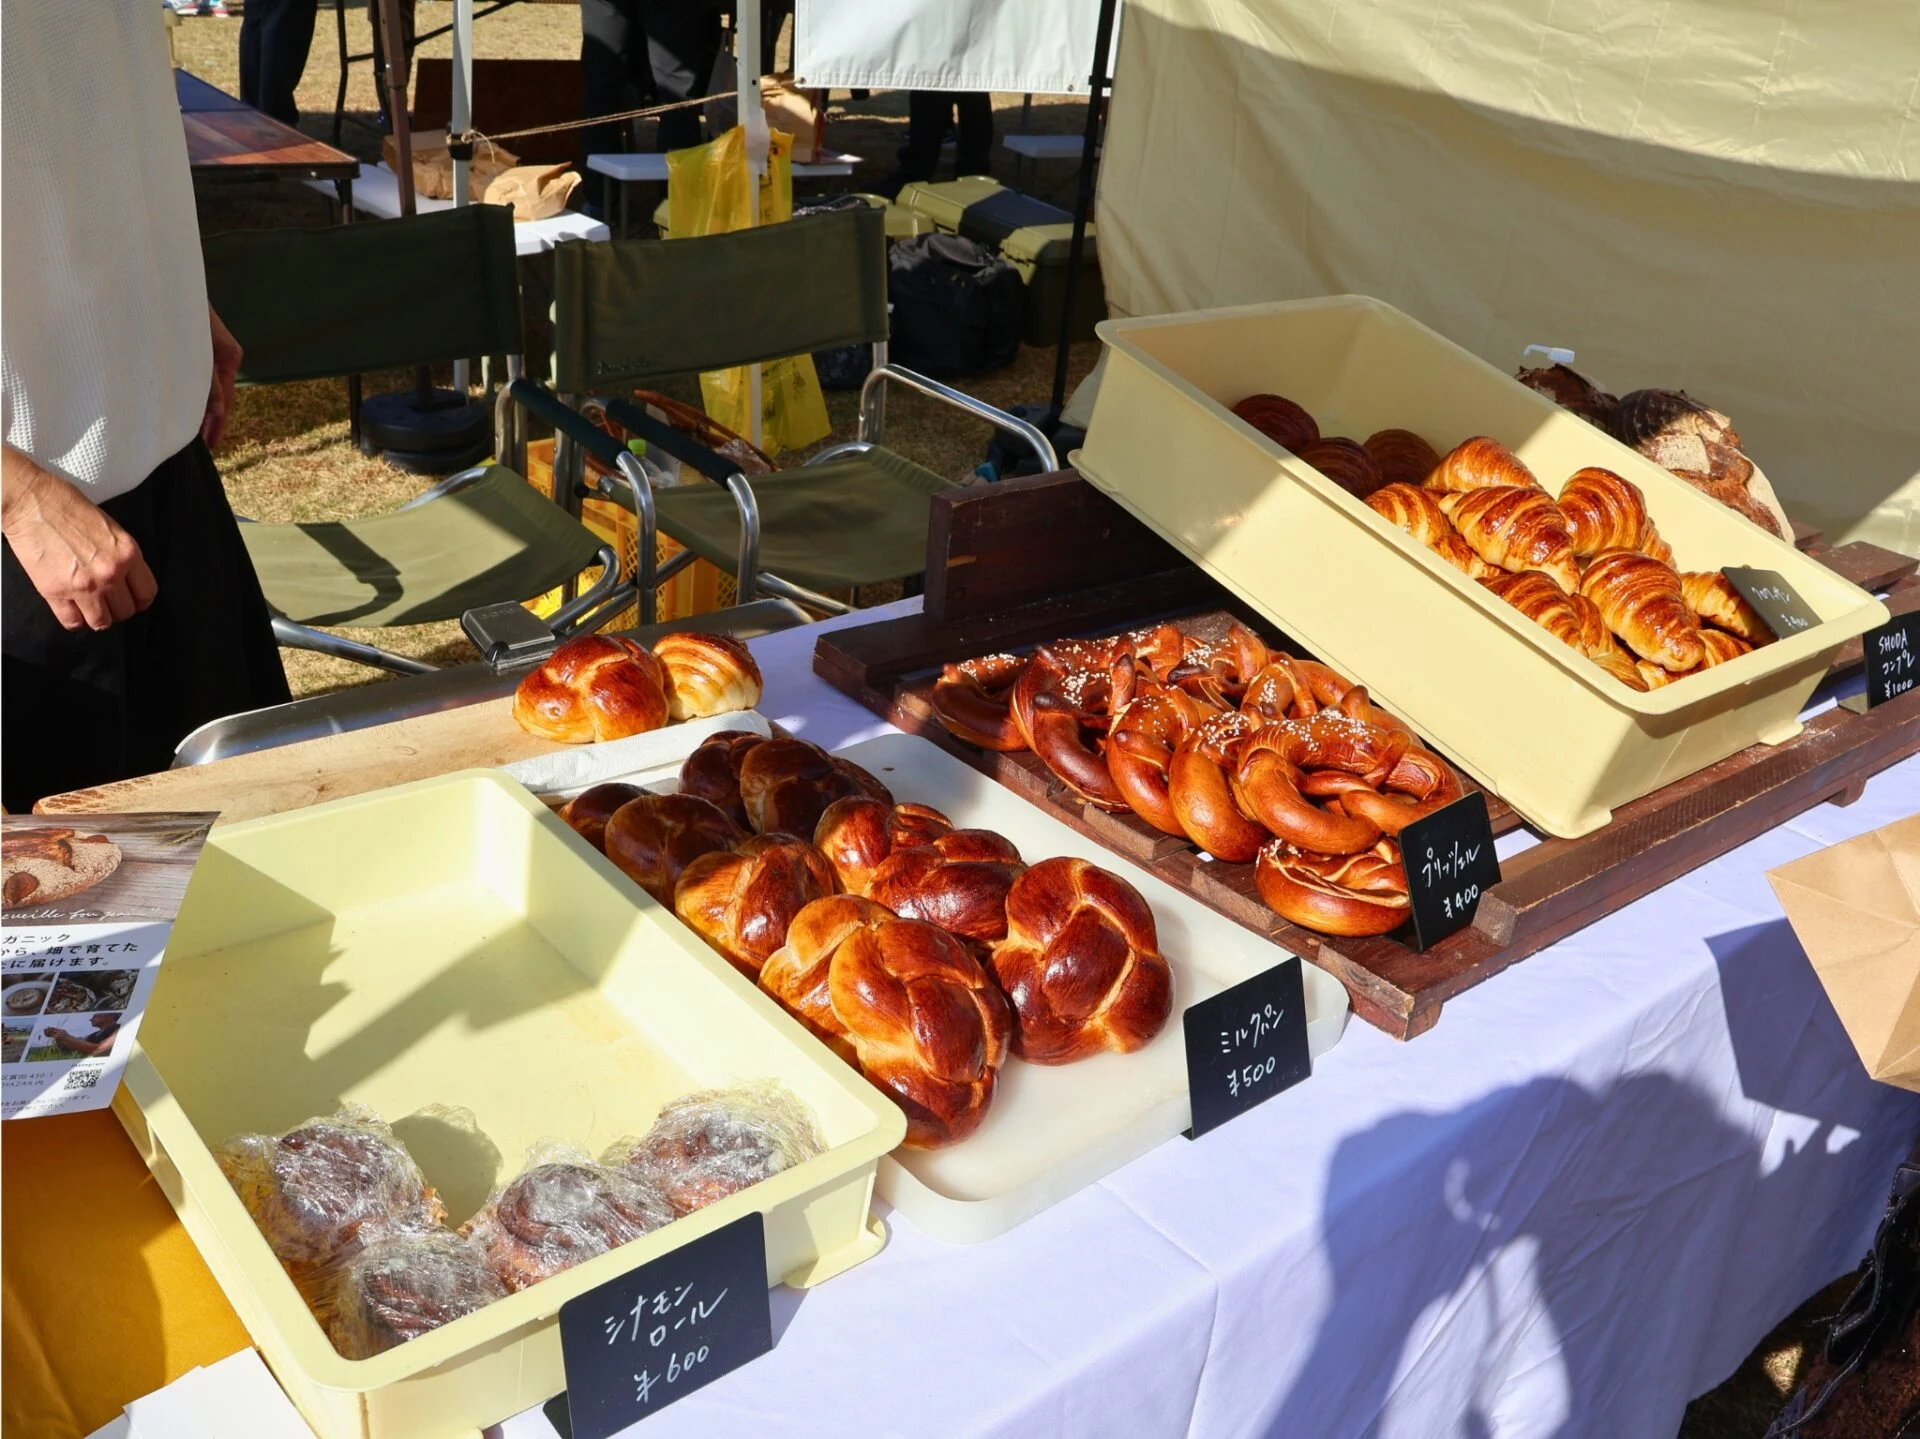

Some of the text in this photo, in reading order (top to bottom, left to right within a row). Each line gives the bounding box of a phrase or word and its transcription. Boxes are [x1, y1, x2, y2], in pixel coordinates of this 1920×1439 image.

[1878, 627, 1908, 655] SHODA
[1884, 679, 1913, 699] ¥1000
[1443, 883, 1479, 919] ¥400
[1220, 1003, 1284, 1054] ミルクパン
[1226, 1056, 1276, 1097] ¥500
[604, 1282, 694, 1345] シナモン
[649, 1287, 729, 1347] ロール
[633, 1345, 710, 1404] ¥600
